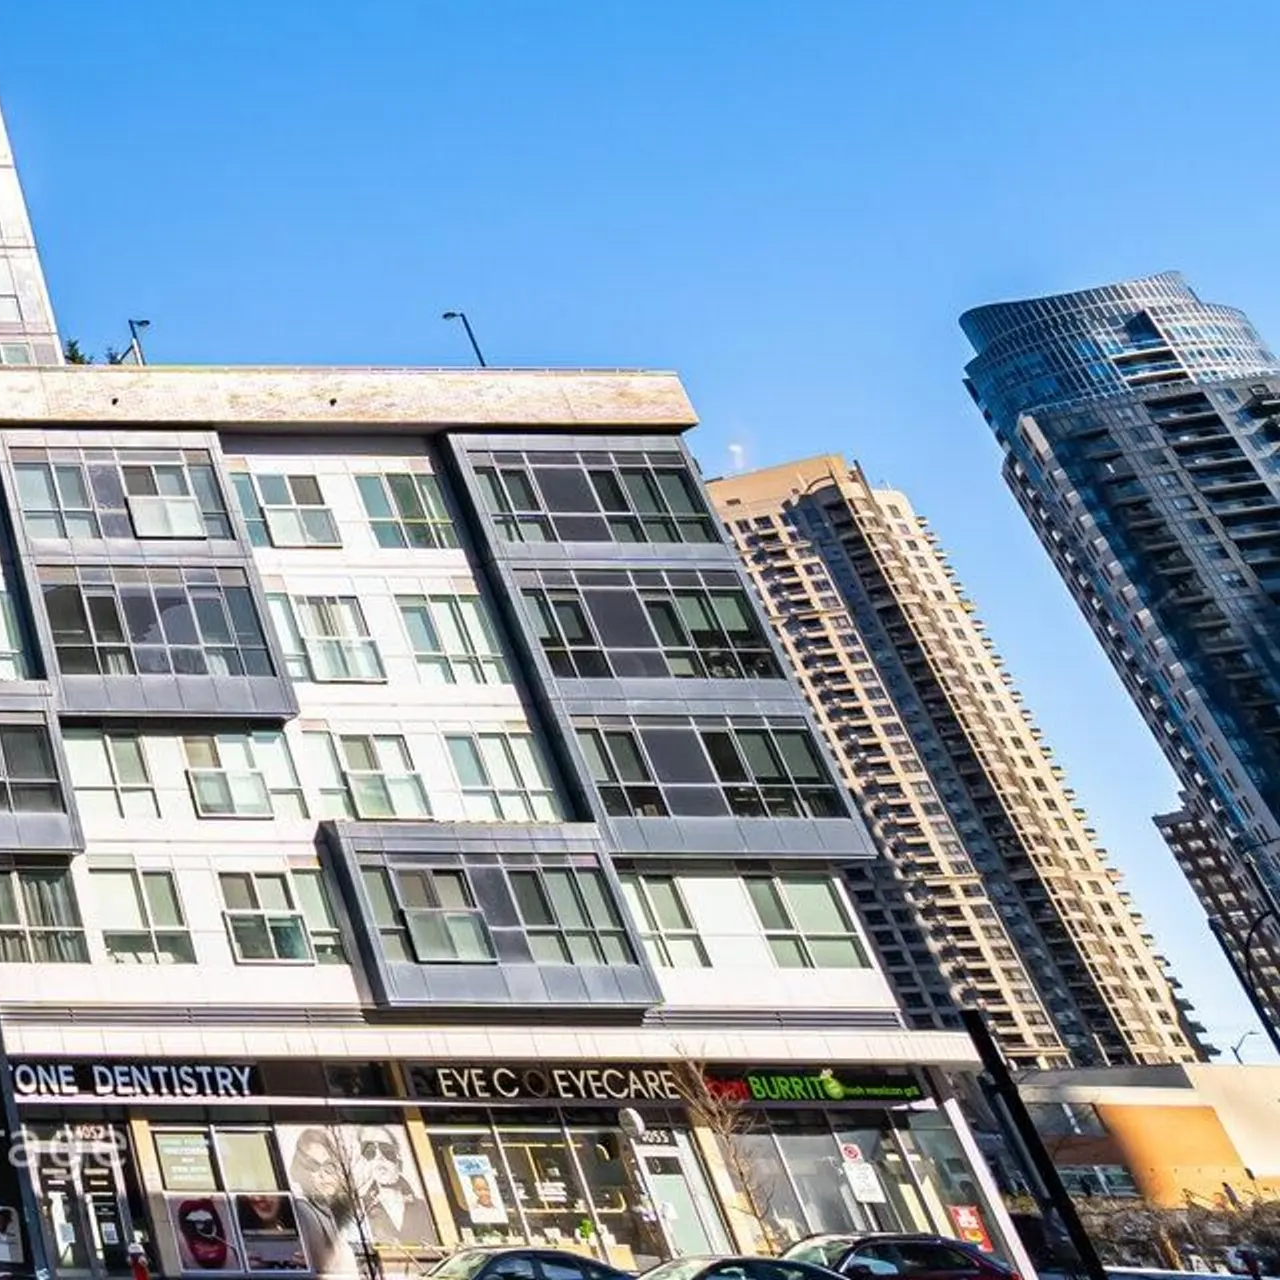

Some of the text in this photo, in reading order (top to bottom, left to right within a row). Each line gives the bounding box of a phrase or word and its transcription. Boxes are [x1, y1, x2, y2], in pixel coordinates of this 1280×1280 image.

[92, 1064, 252, 1096] DENTISTRY
[437, 1068, 490, 1098] EYE
[552, 1069, 680, 1100] EYECARE
